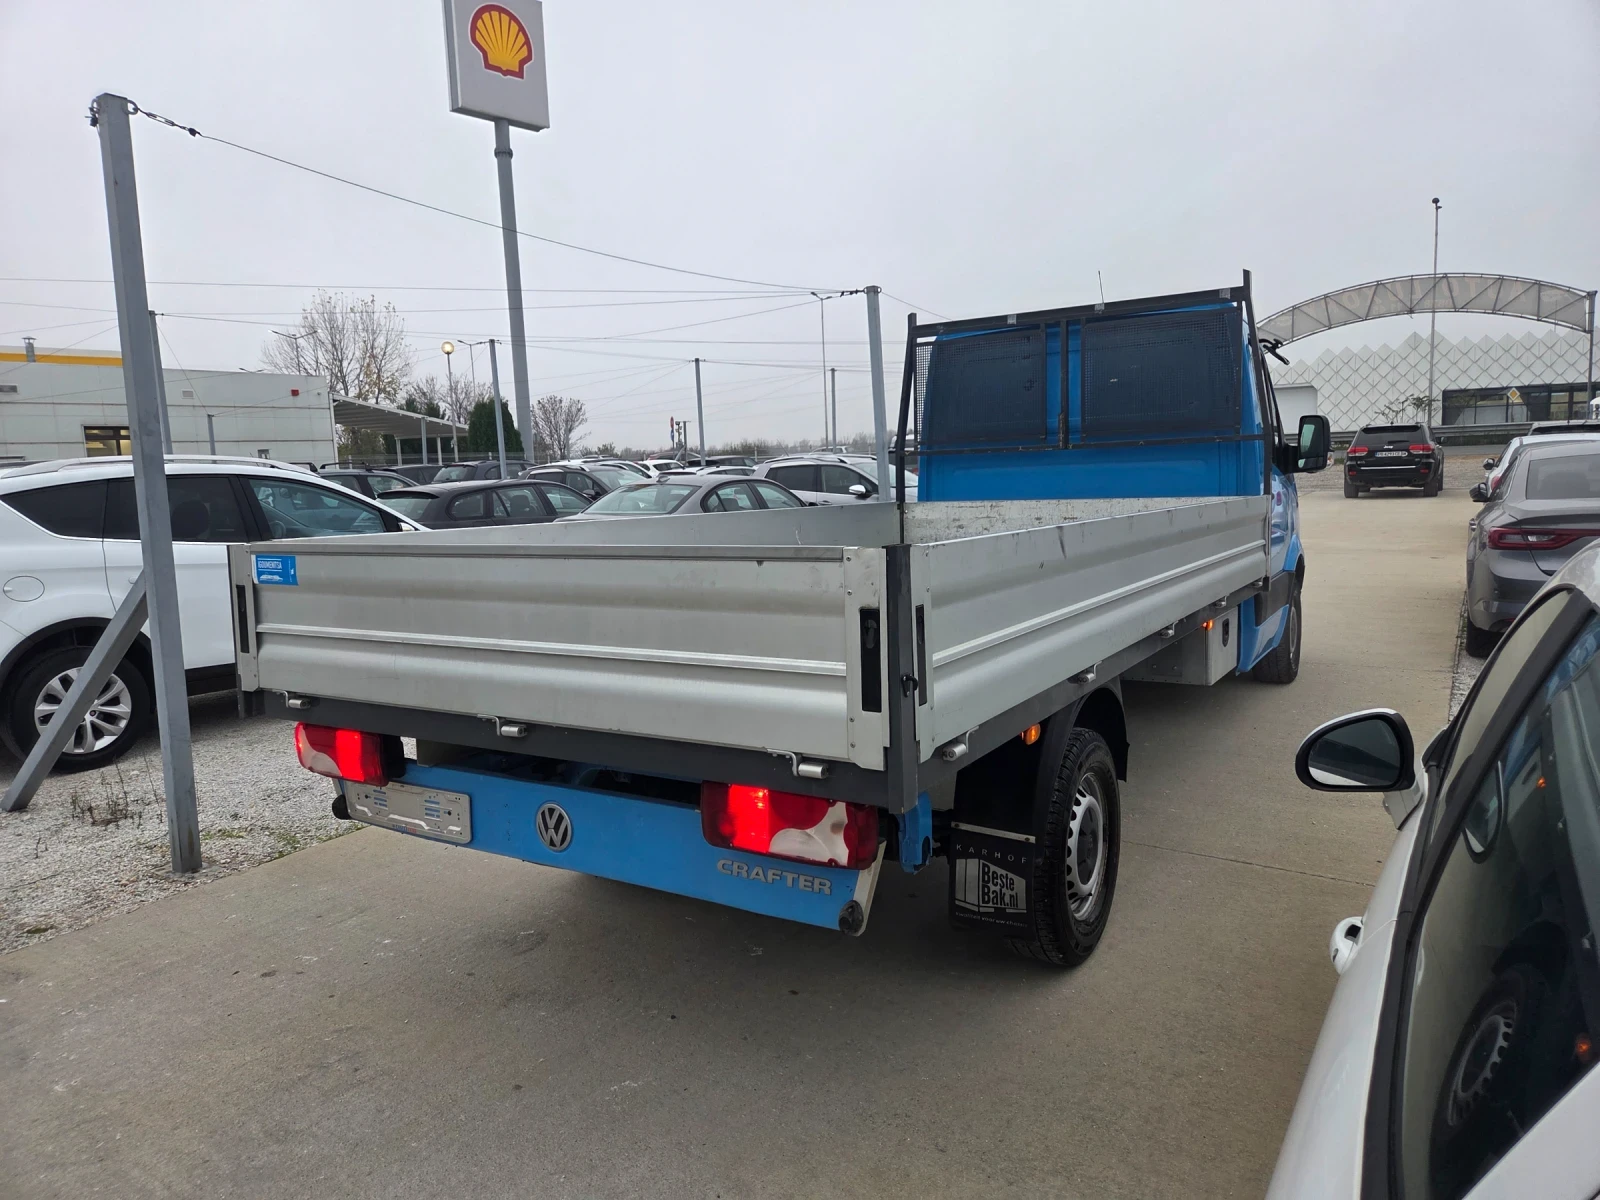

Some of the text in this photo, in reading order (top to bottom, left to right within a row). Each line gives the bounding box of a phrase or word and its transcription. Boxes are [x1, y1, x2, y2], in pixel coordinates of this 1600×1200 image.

[956, 843, 1027, 864] KARHOF
[716, 859, 832, 895] CRAFTER
[981, 862, 1015, 892] Beste
[981, 883, 1019, 908] Bak.nl
